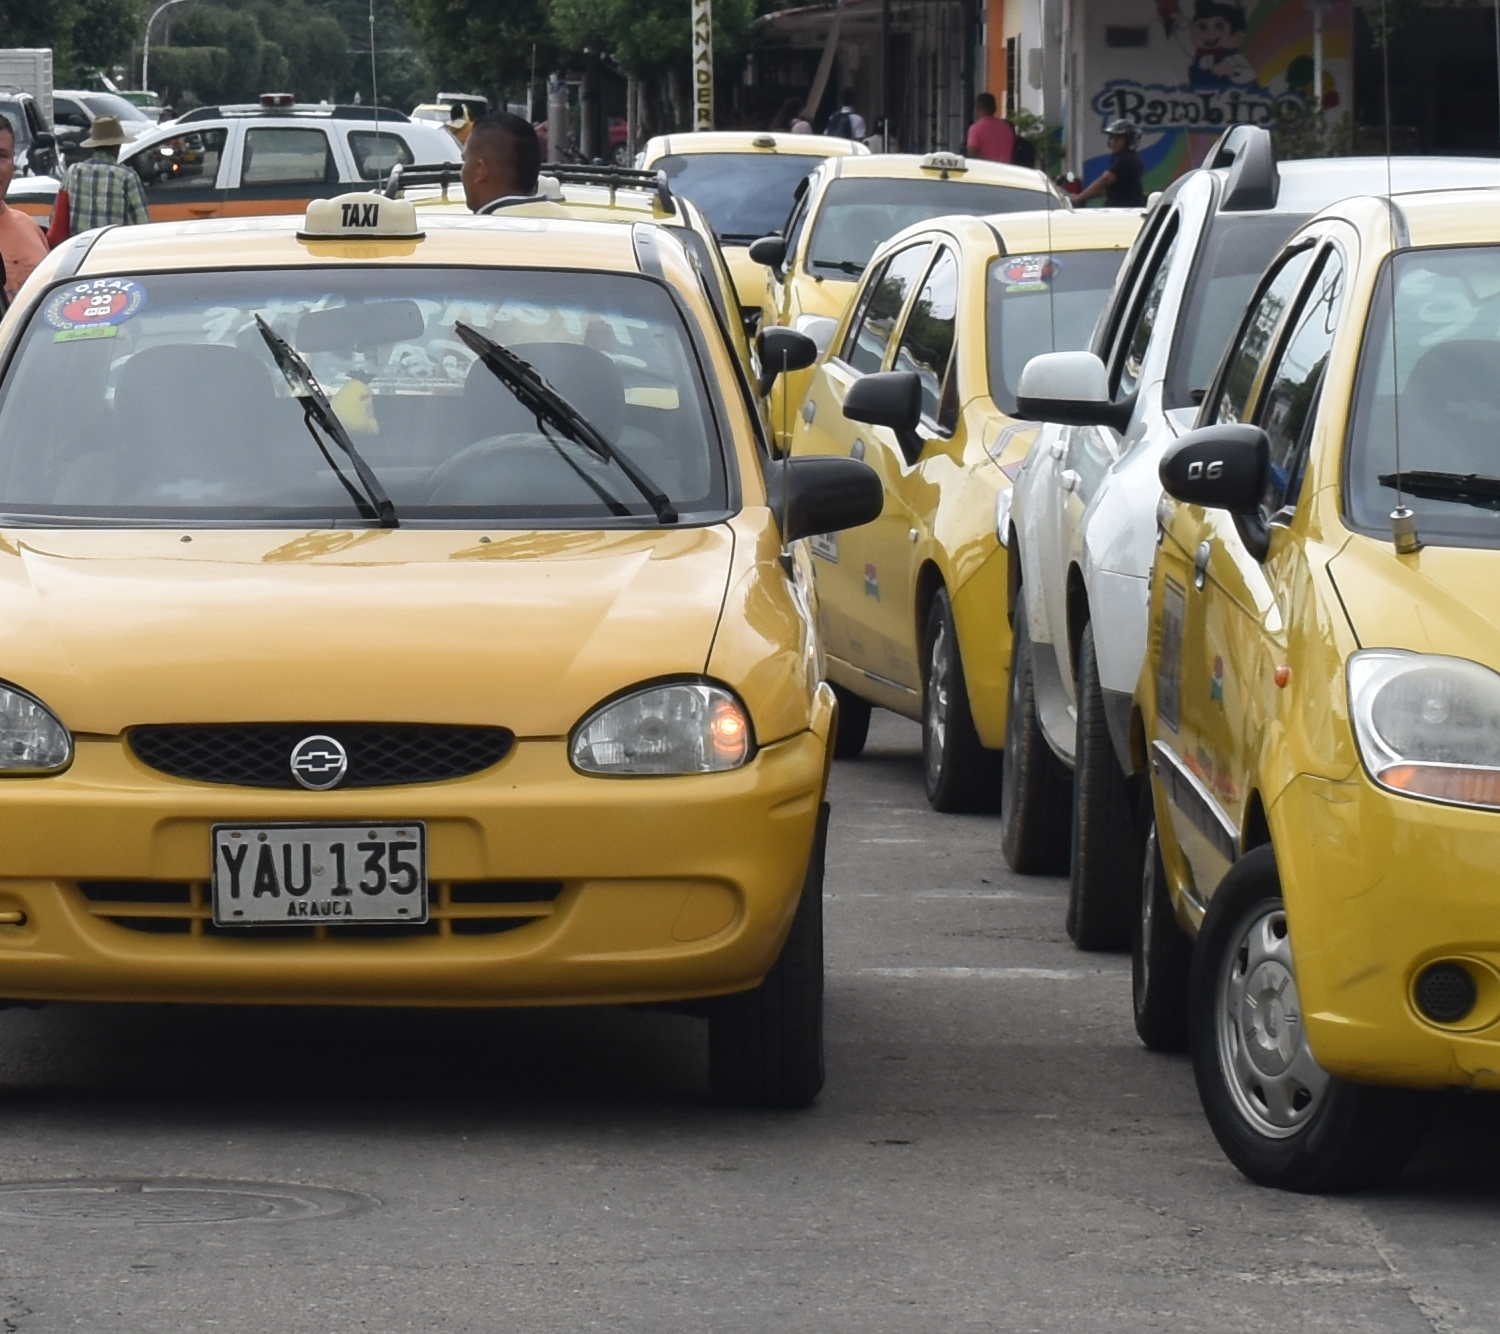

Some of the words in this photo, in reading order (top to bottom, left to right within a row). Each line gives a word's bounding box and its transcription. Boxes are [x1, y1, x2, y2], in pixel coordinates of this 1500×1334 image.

[340, 202, 380, 228] TAXI
[75, 279, 135, 293] ORAL
[220, 841, 313, 900] YAU
[328, 840, 419, 897] 135
[287, 899, 354, 917] ARAUCA
